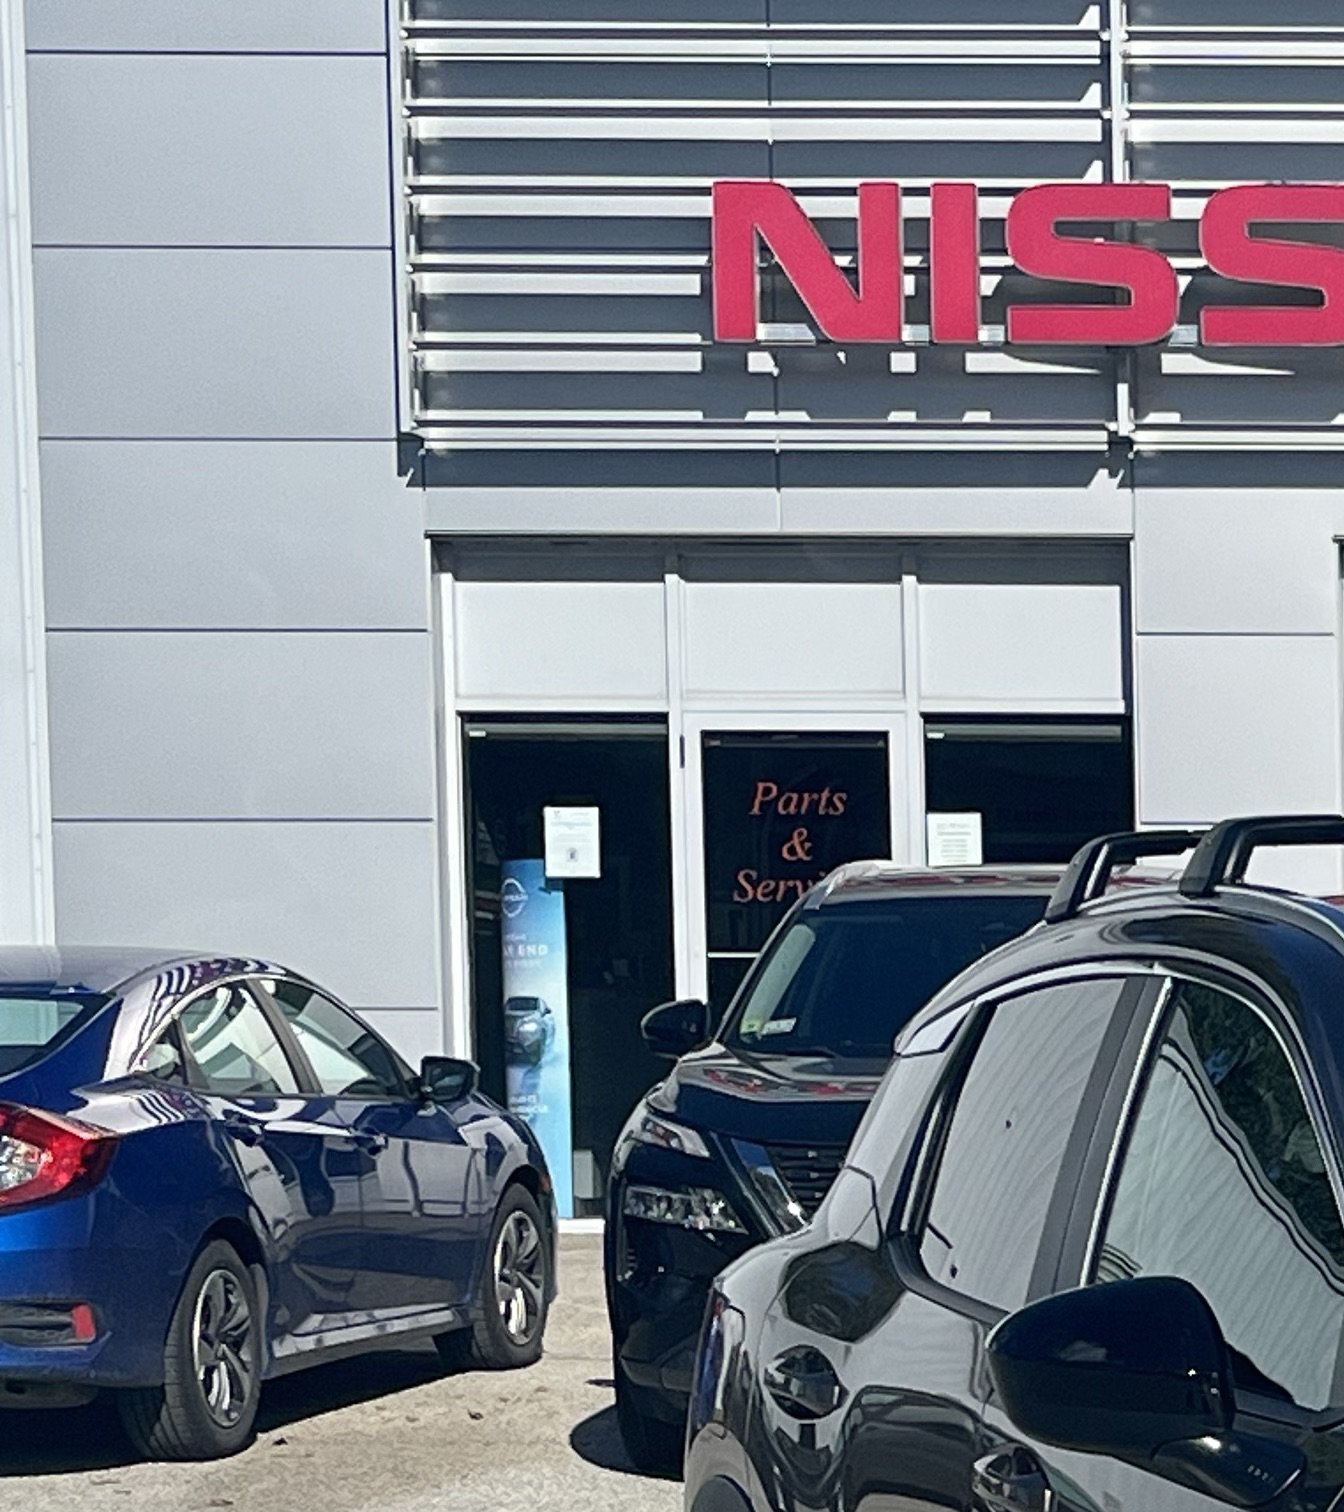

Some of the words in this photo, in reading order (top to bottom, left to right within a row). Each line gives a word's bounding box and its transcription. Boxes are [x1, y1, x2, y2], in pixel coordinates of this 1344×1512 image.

[748, 781, 848, 815] Parts
[781, 827, 813, 861] &
[732, 868, 827, 903] Serv
